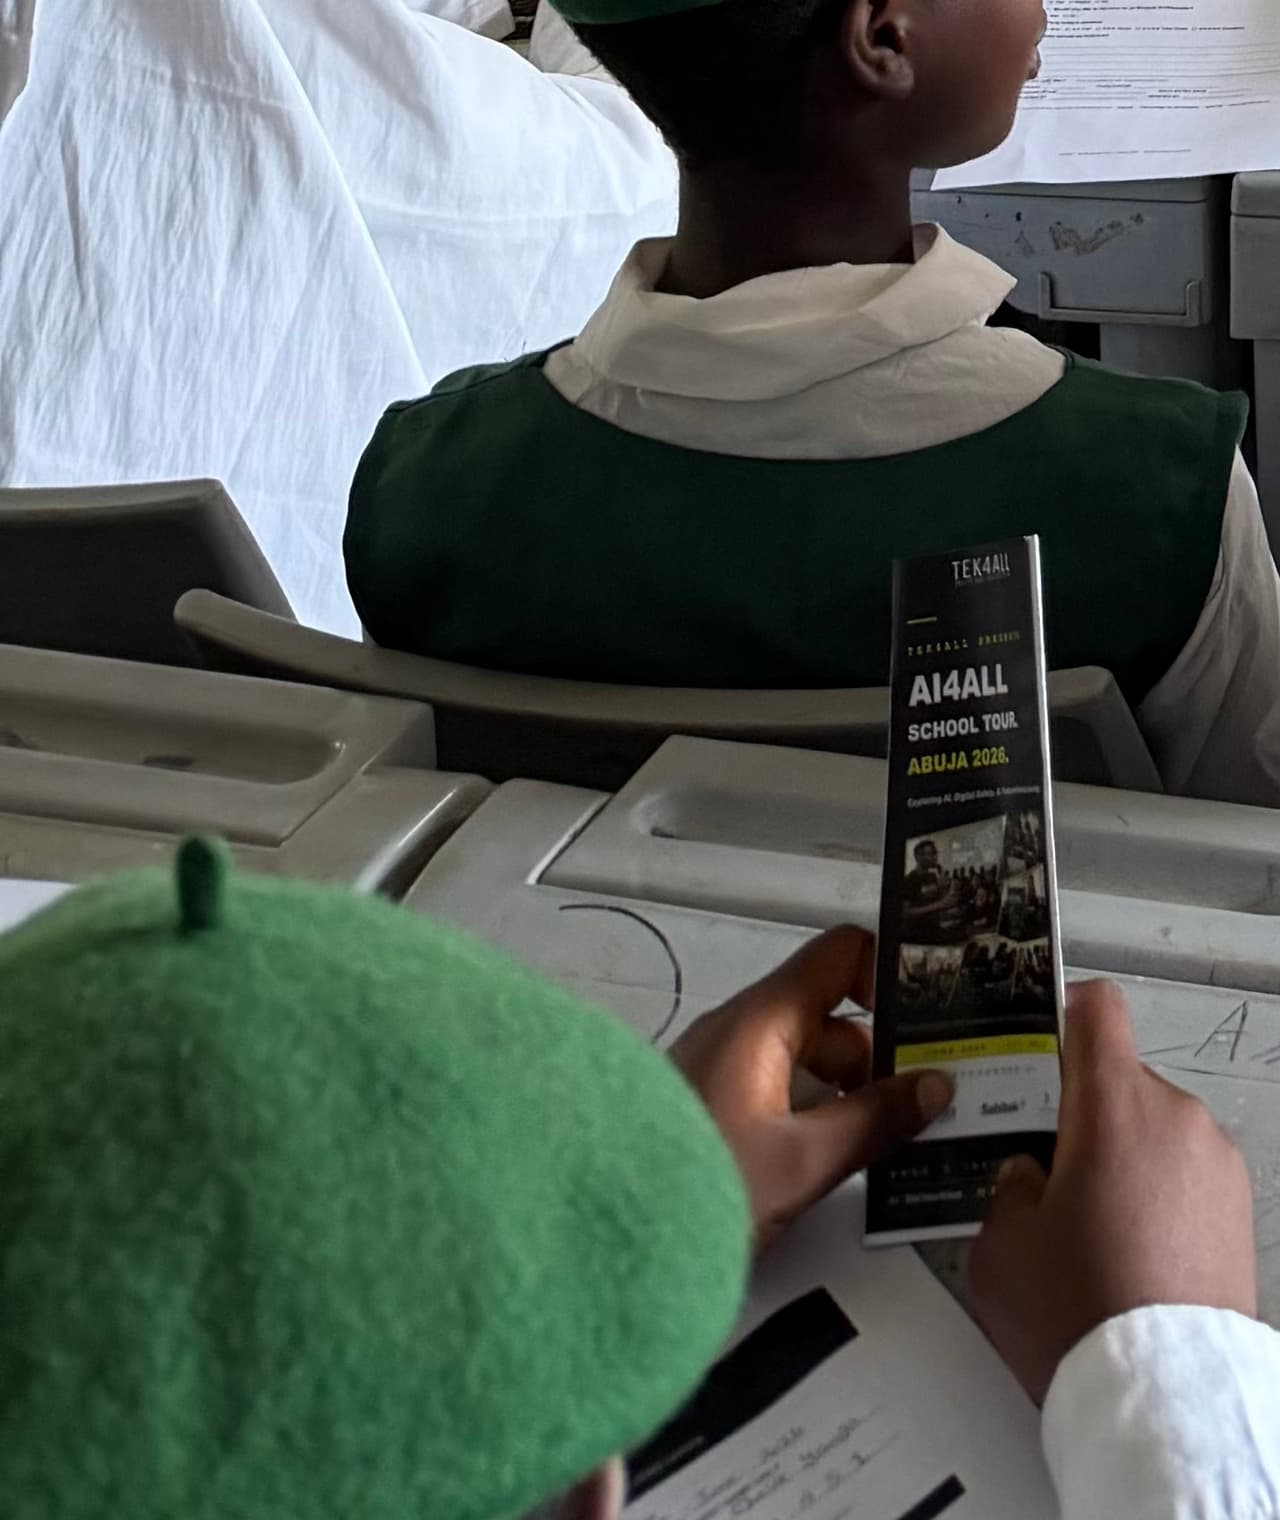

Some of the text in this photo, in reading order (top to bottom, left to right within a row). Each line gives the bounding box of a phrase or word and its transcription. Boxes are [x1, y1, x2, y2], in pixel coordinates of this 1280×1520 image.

[952, 552, 1011, 581] TEK4ALL
[908, 663, 1009, 707] AI4ALL
[908, 715, 979, 742] SCHOOL
[907, 751, 969, 776] ABUJA
